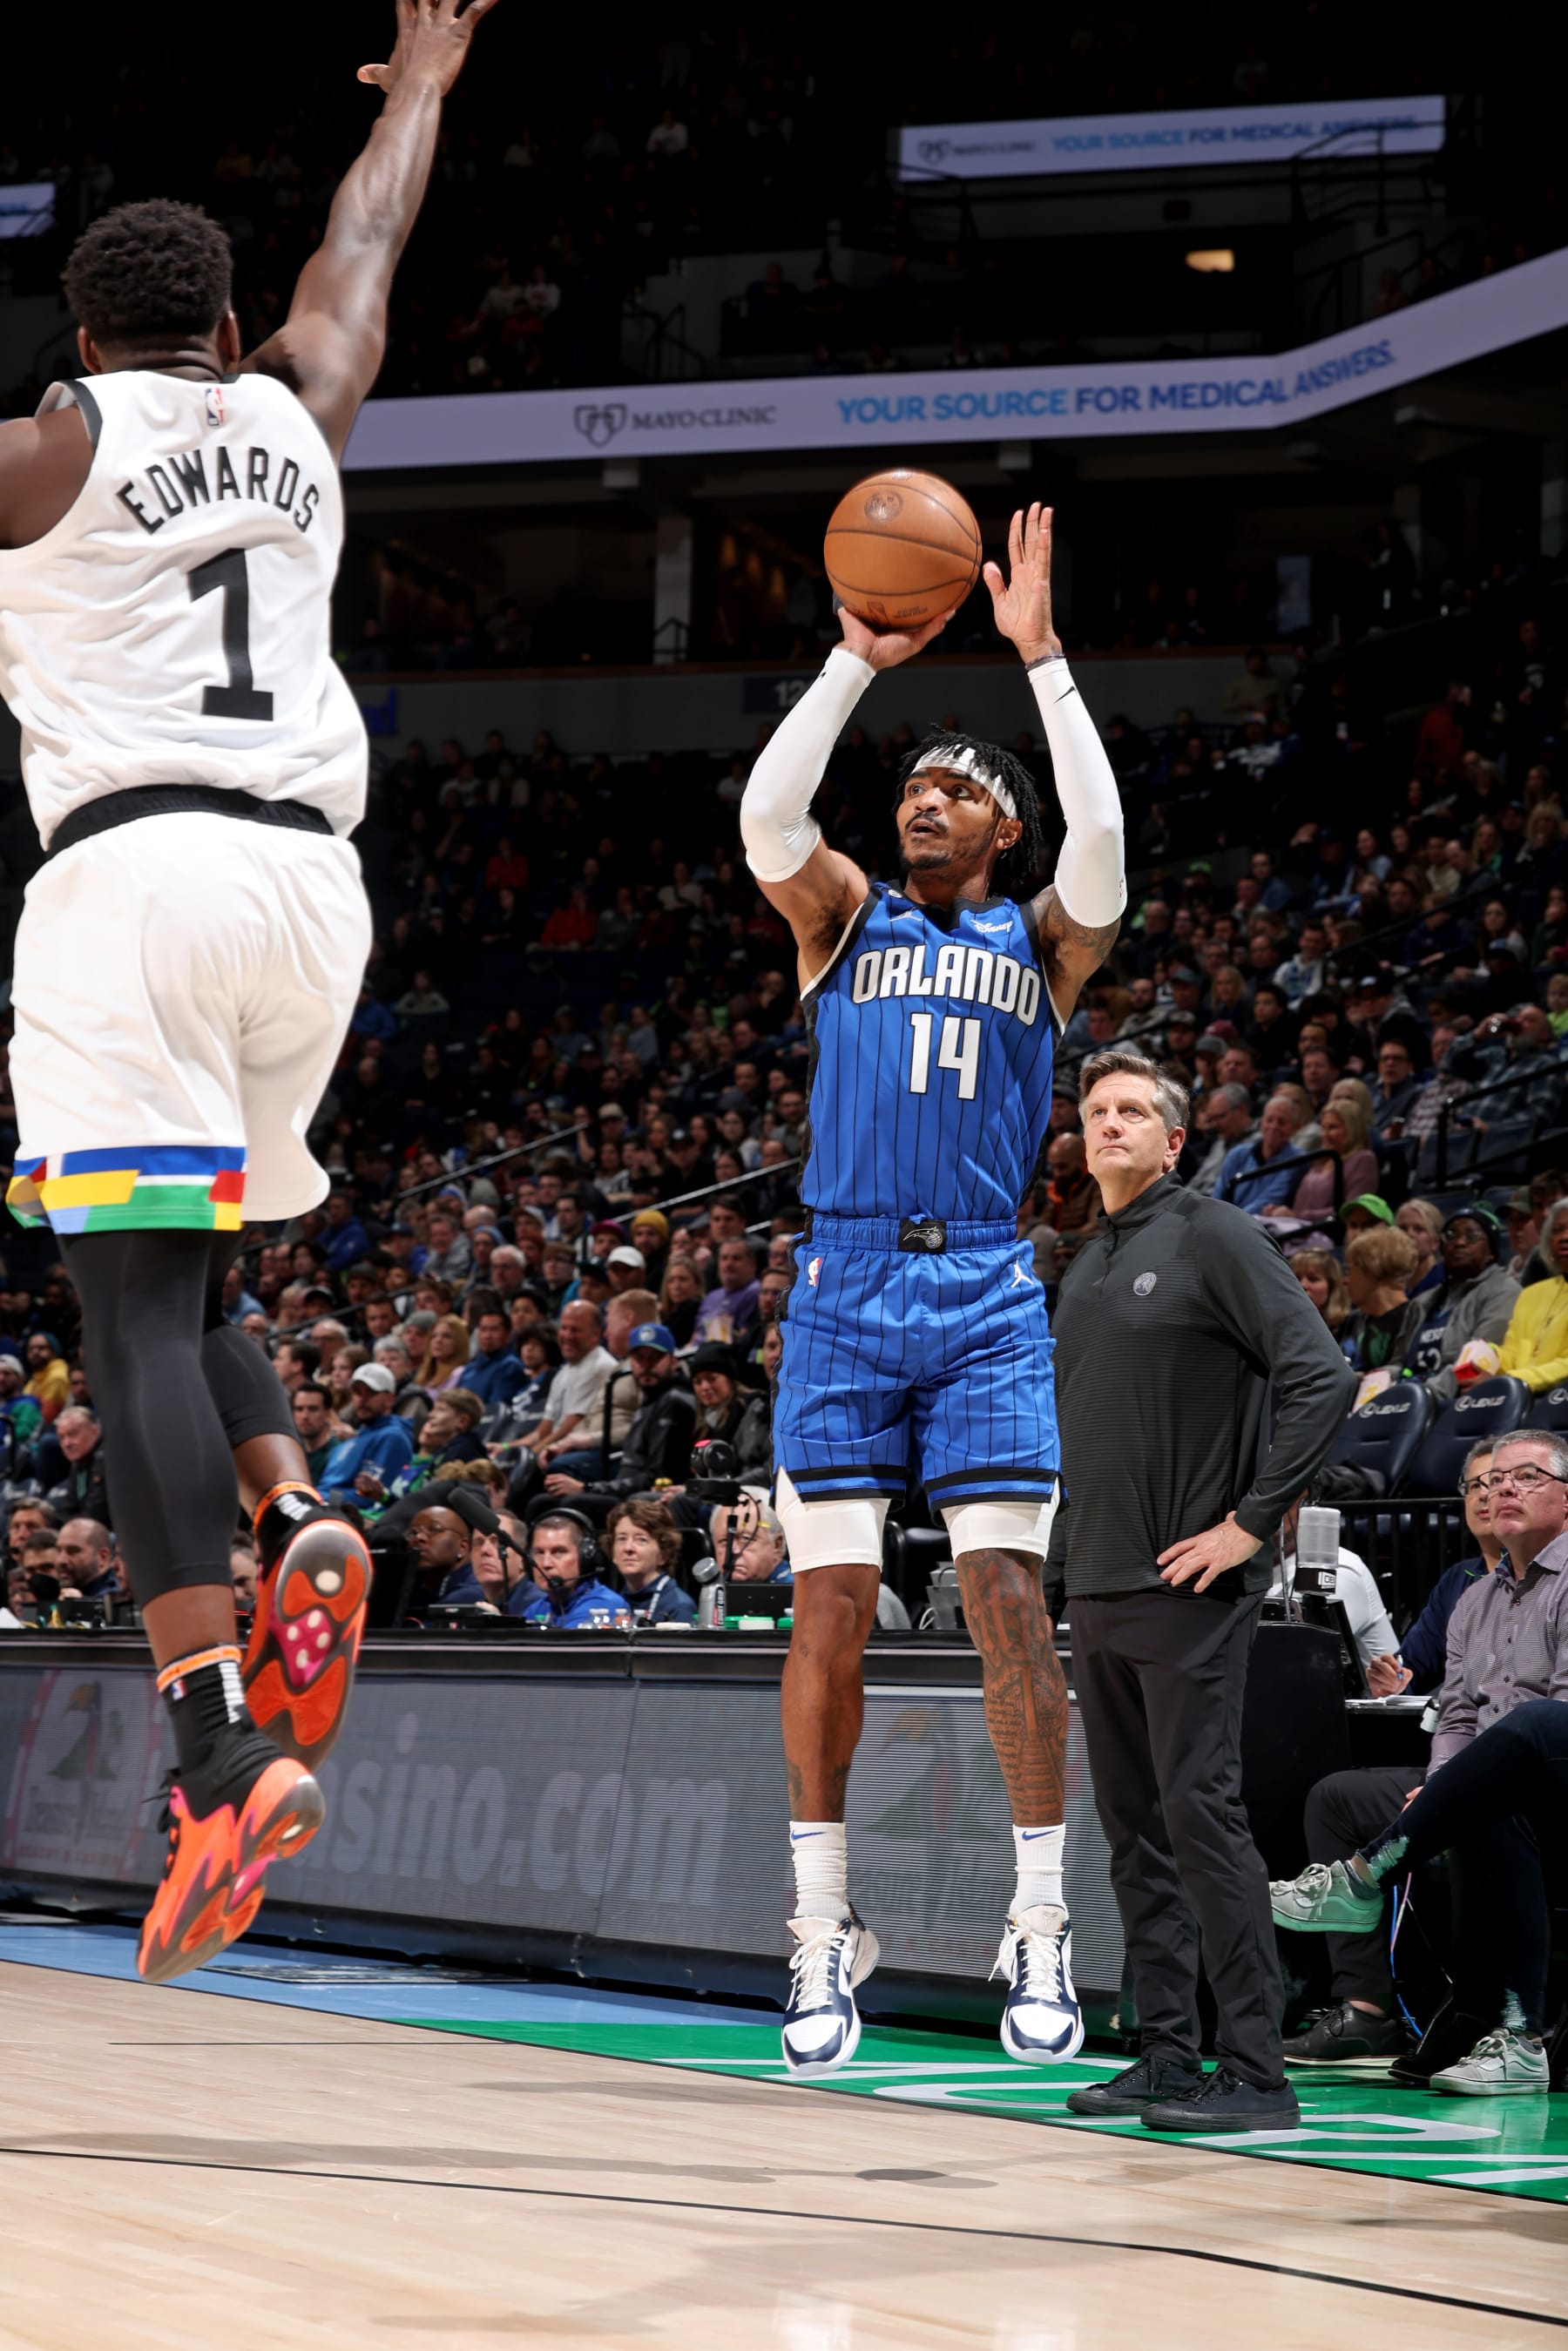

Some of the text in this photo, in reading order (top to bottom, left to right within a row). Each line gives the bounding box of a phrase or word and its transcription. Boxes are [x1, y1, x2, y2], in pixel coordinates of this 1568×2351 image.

[1052, 134, 1102, 152] YOUR
[1109, 128, 1184, 149] SOURCE
[1188, 126, 1227, 144] FOR
[1230, 121, 1315, 142] MEDICAL
[632, 406, 777, 431] MAYO CLINIC
[837, 339, 1396, 425] YOUR SOURCE FOR MEDICAL ANSWERS
[116, 446, 320, 535] EDWARDS
[186, 547, 274, 721] 1
[852, 944, 1040, 1027] ORLANDO
[909, 1012, 982, 1101] 14
[294, 1711, 730, 1908] asino.com
